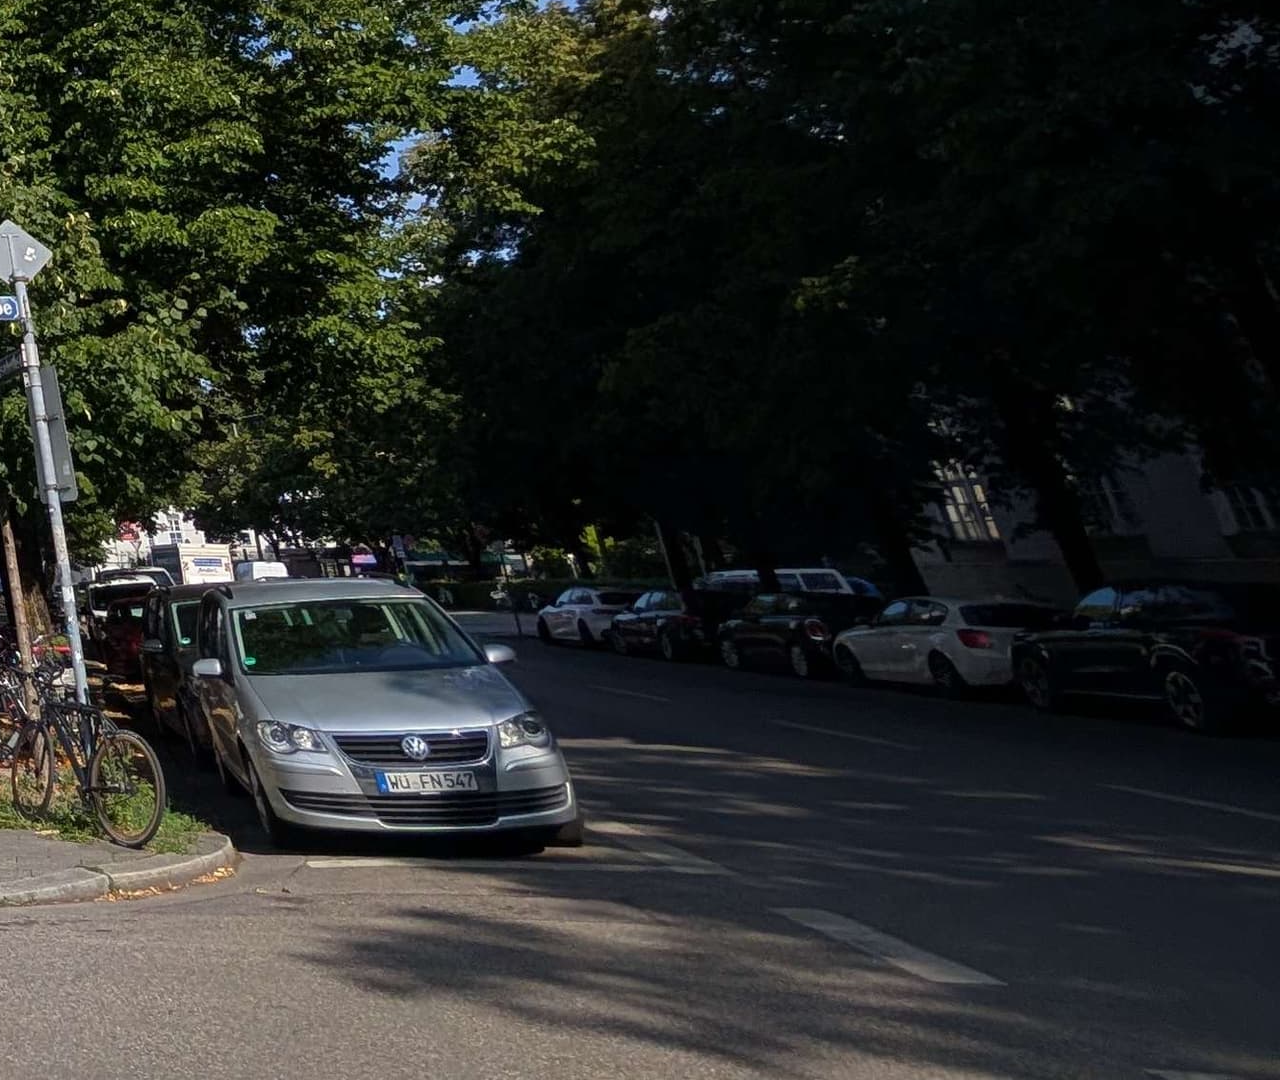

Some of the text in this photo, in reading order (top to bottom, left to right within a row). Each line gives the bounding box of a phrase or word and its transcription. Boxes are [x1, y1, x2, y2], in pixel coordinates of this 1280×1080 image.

[388, 772, 474, 789] WÜ FN 547
